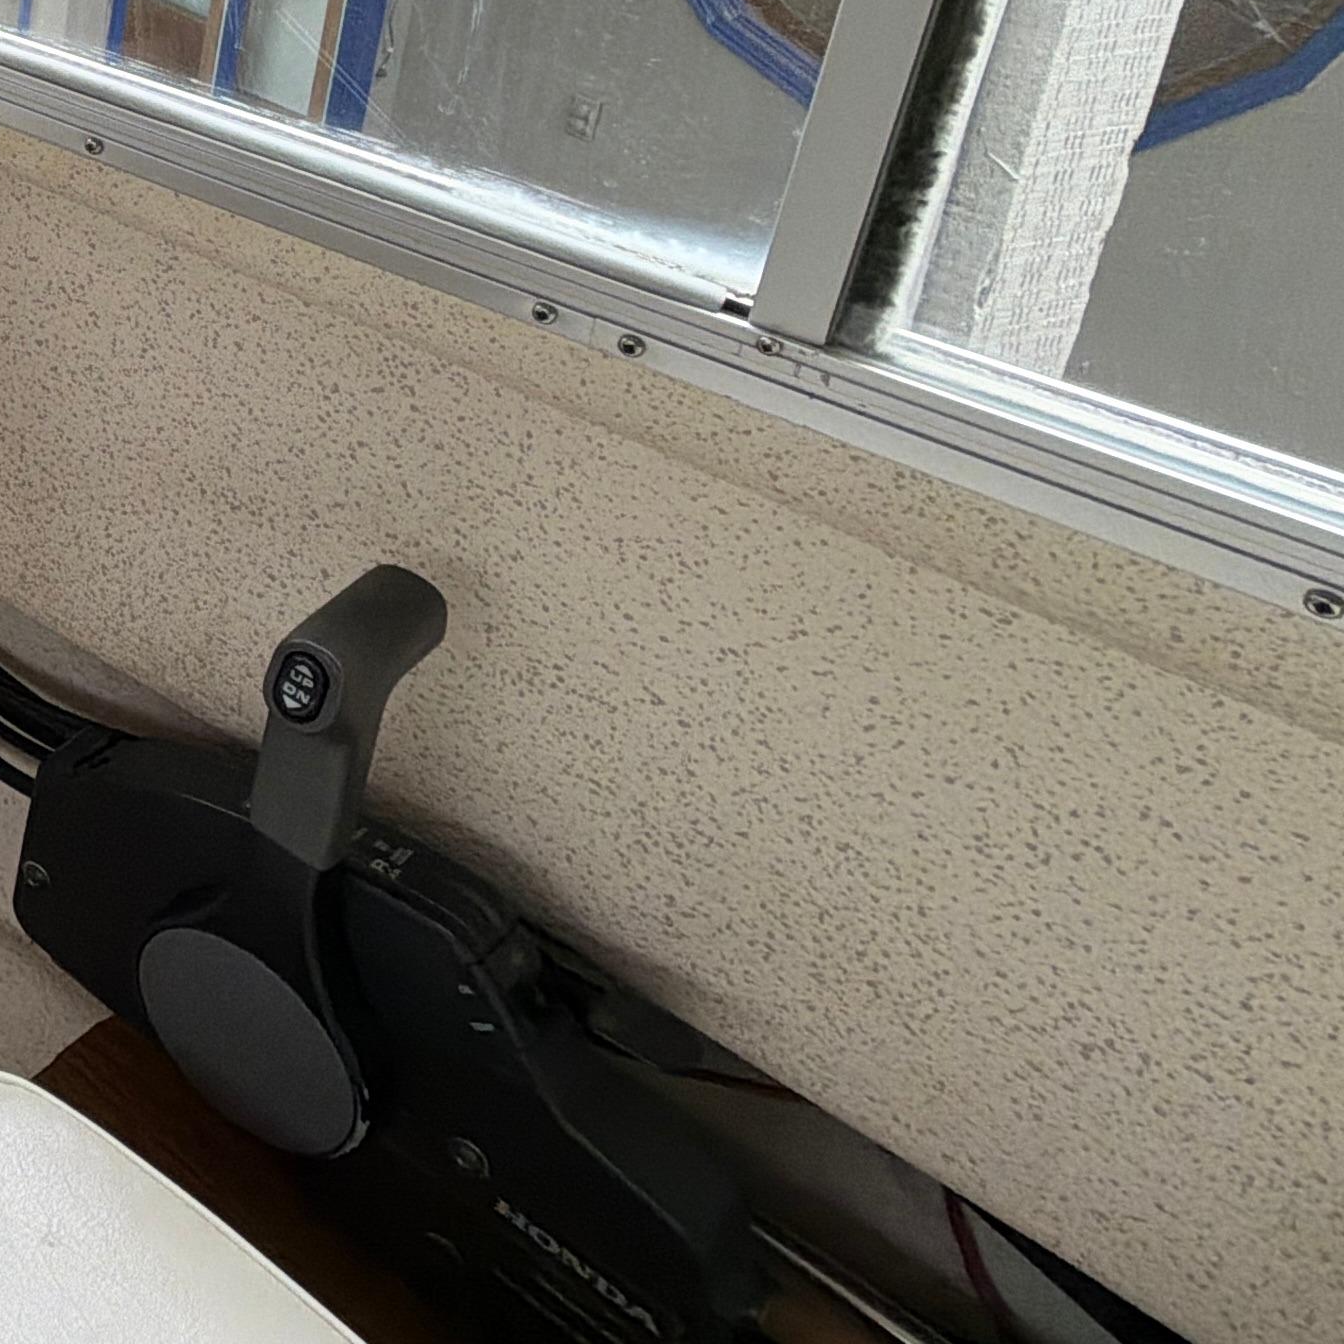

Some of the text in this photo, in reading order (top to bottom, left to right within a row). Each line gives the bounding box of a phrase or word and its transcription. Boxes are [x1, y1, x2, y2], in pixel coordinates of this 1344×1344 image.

[289, 668, 315, 689] UP
[282, 680, 311, 705] DN
[493, 1195, 663, 1339] HONDA
